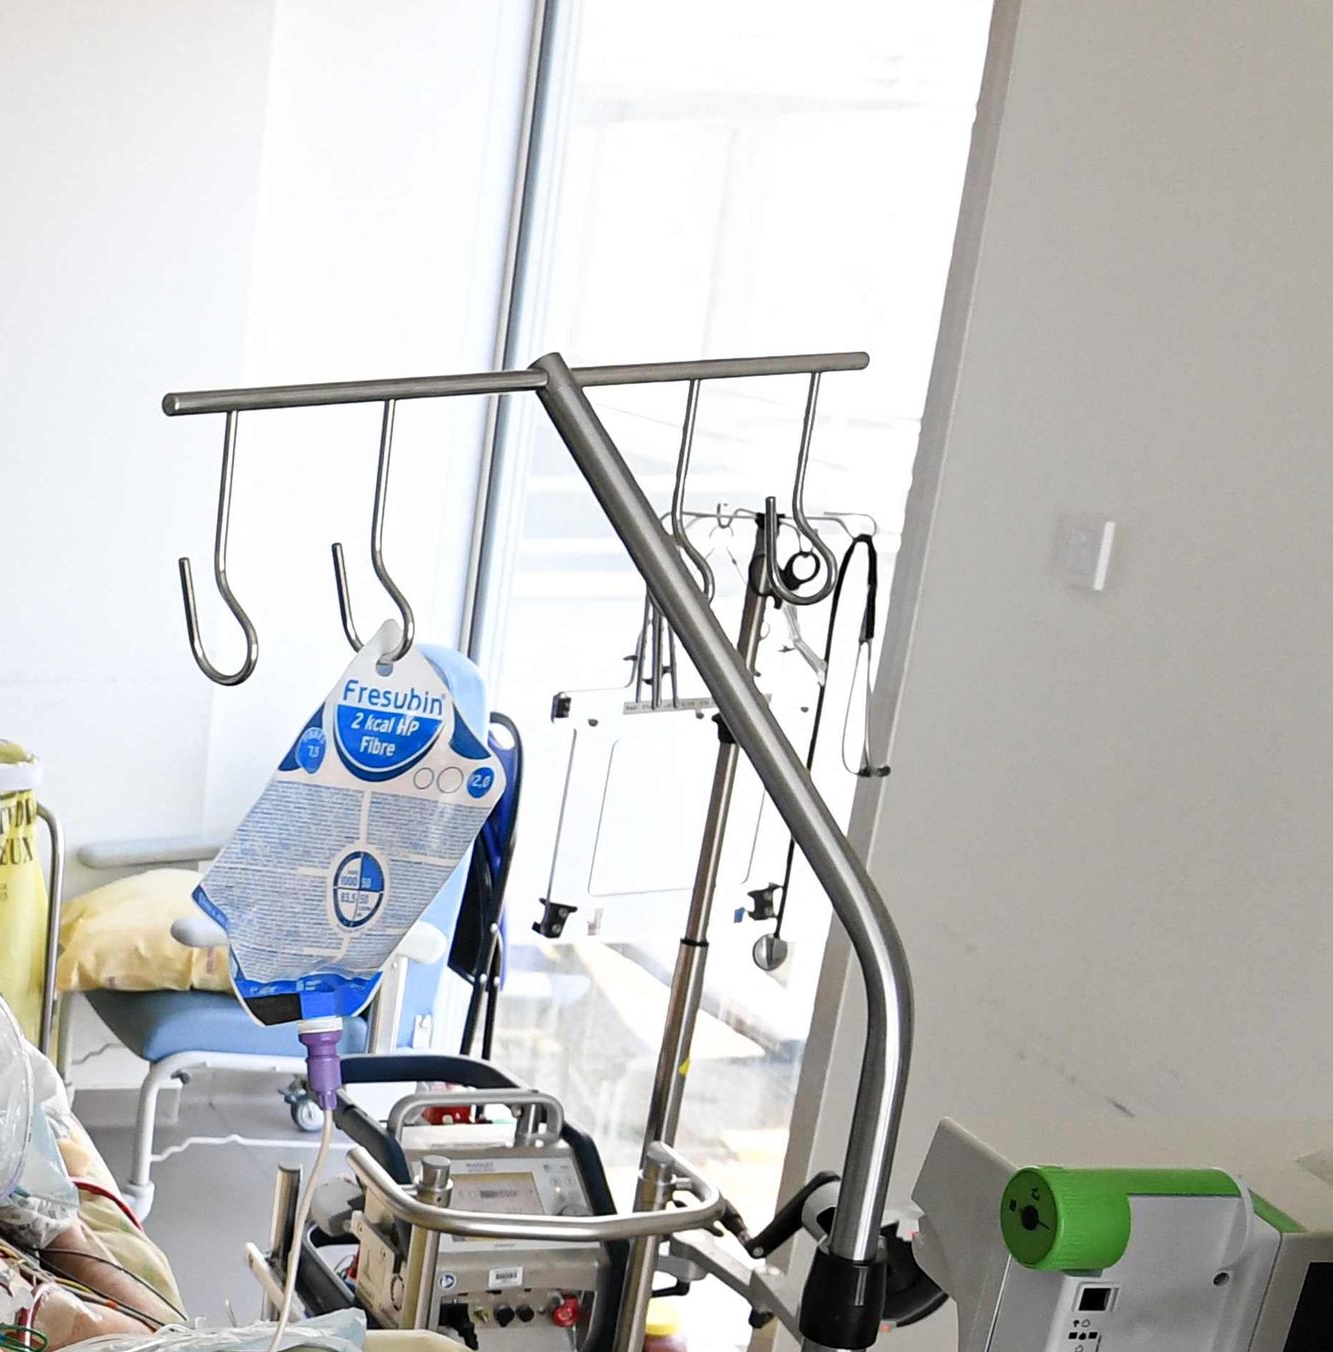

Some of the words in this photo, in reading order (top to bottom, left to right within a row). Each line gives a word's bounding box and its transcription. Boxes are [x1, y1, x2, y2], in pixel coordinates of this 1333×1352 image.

[342, 679, 443, 716] Fresubin
[351, 712, 363, 729] 2
[364, 714, 393, 733] kcal
[396, 716, 421, 737] HP
[359, 736, 396, 756] Fibre
